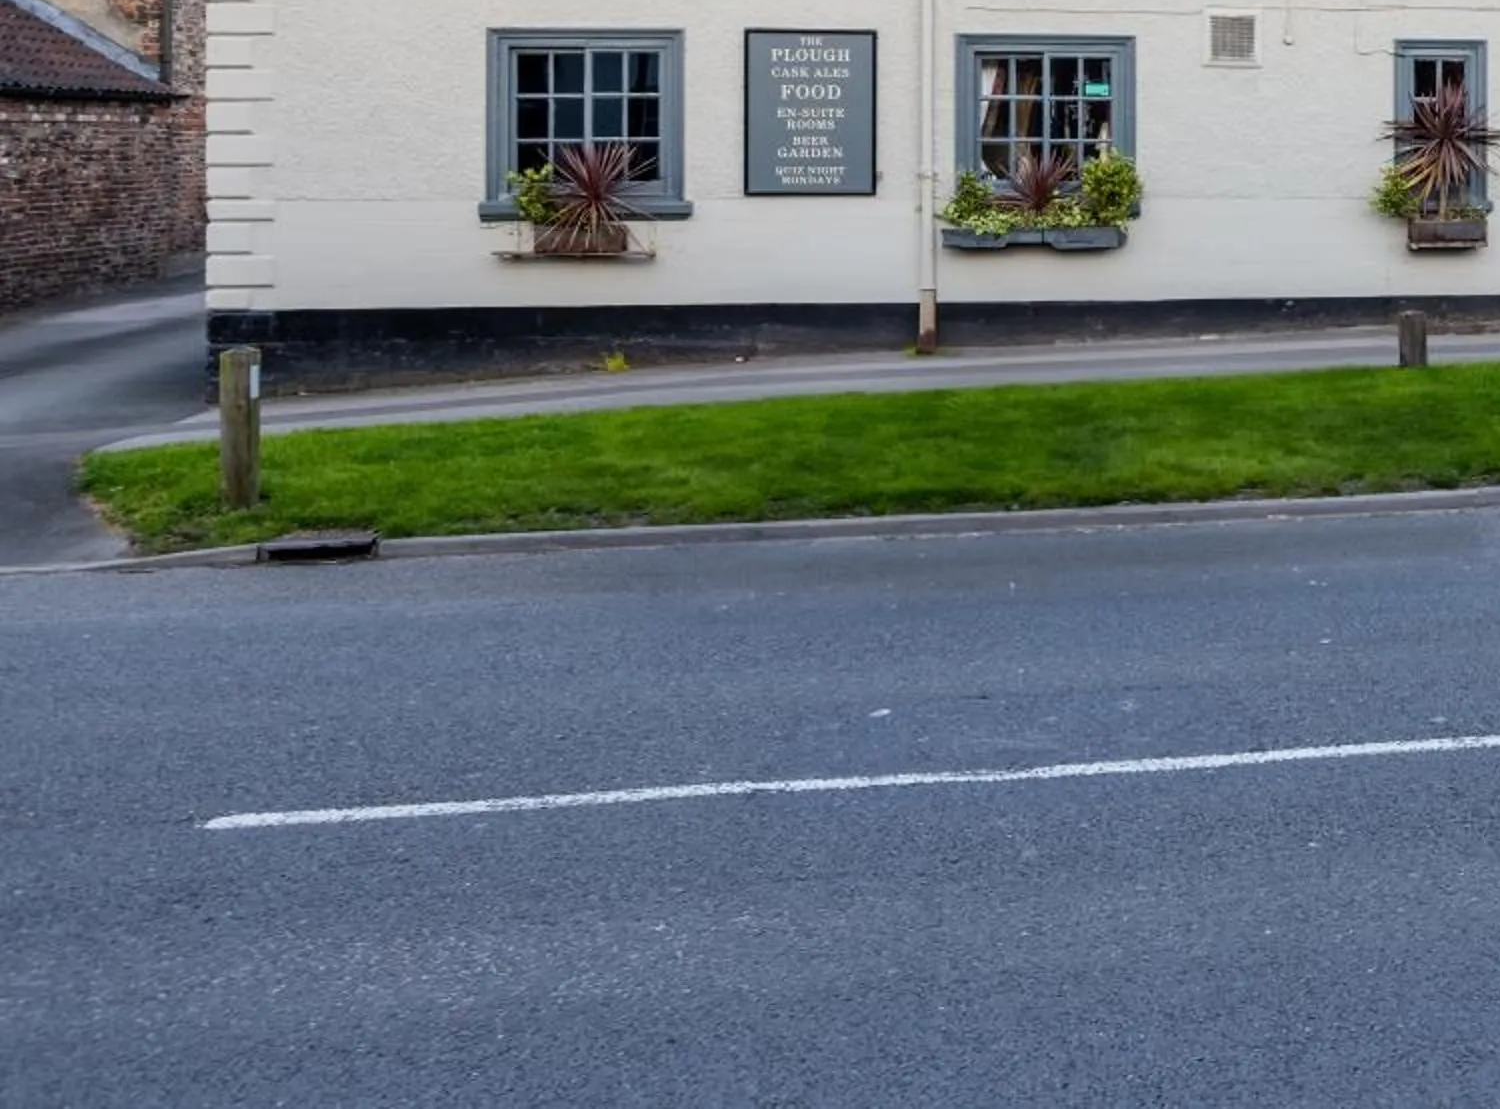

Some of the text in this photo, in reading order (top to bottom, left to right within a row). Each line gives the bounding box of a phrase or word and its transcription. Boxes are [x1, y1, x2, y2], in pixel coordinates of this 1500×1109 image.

[800, 36, 823, 46] THE
[771, 48, 851, 62] PLOUGH
[771, 67, 850, 78] CASK ALES
[781, 84, 841, 100] FOOD
[777, 107, 845, 118] EN-SUITE
[787, 119, 836, 130] ROOMS
[793, 136, 829, 146] BEER
[777, 147, 844, 158] GARDEN
